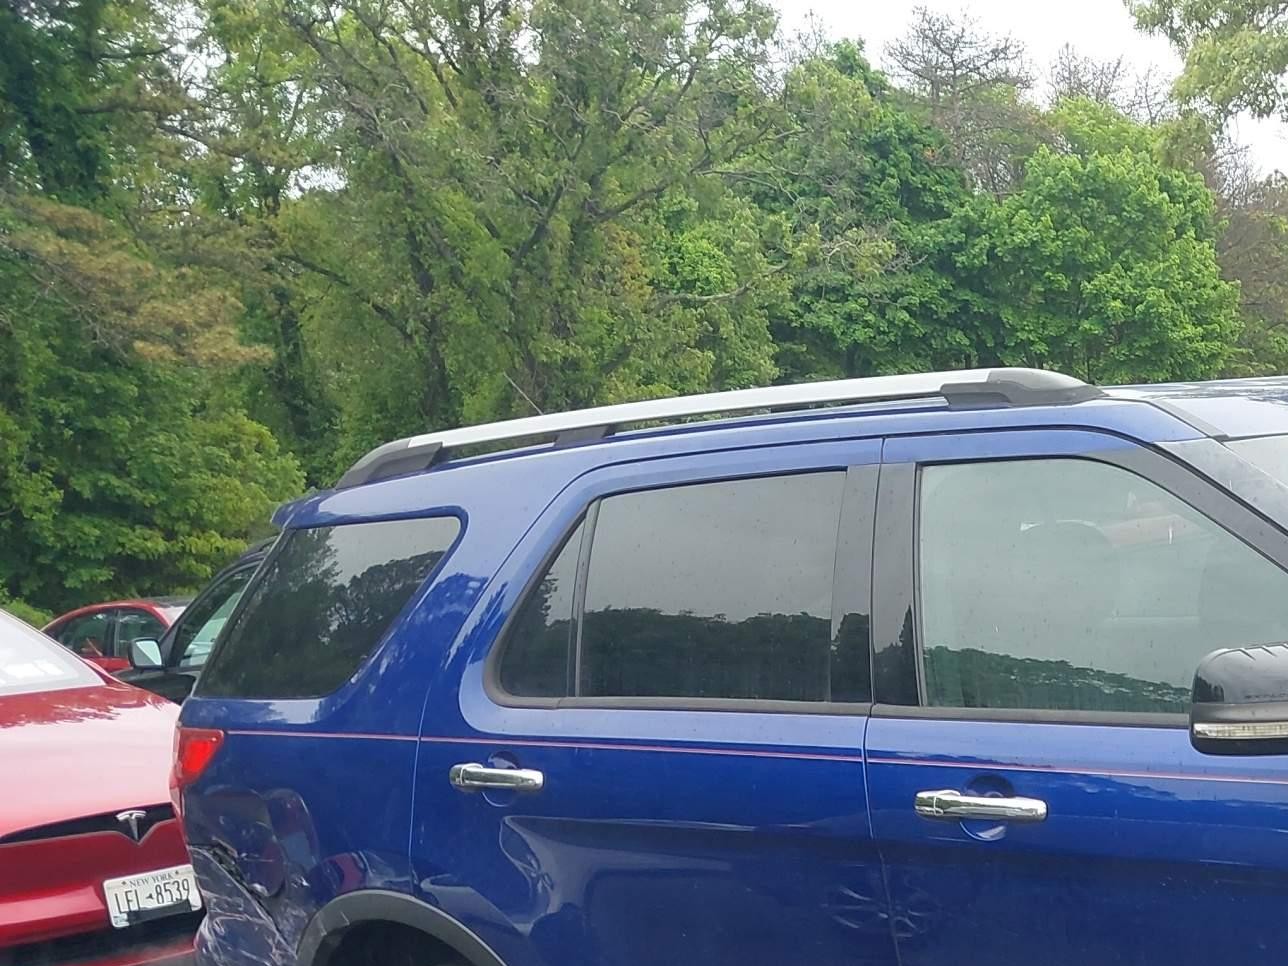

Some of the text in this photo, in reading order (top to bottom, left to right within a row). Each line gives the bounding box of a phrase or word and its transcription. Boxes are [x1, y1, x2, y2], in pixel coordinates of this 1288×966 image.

[129, 872, 174, 888] NEW YORK
[155, 878, 190, 904] 8539
